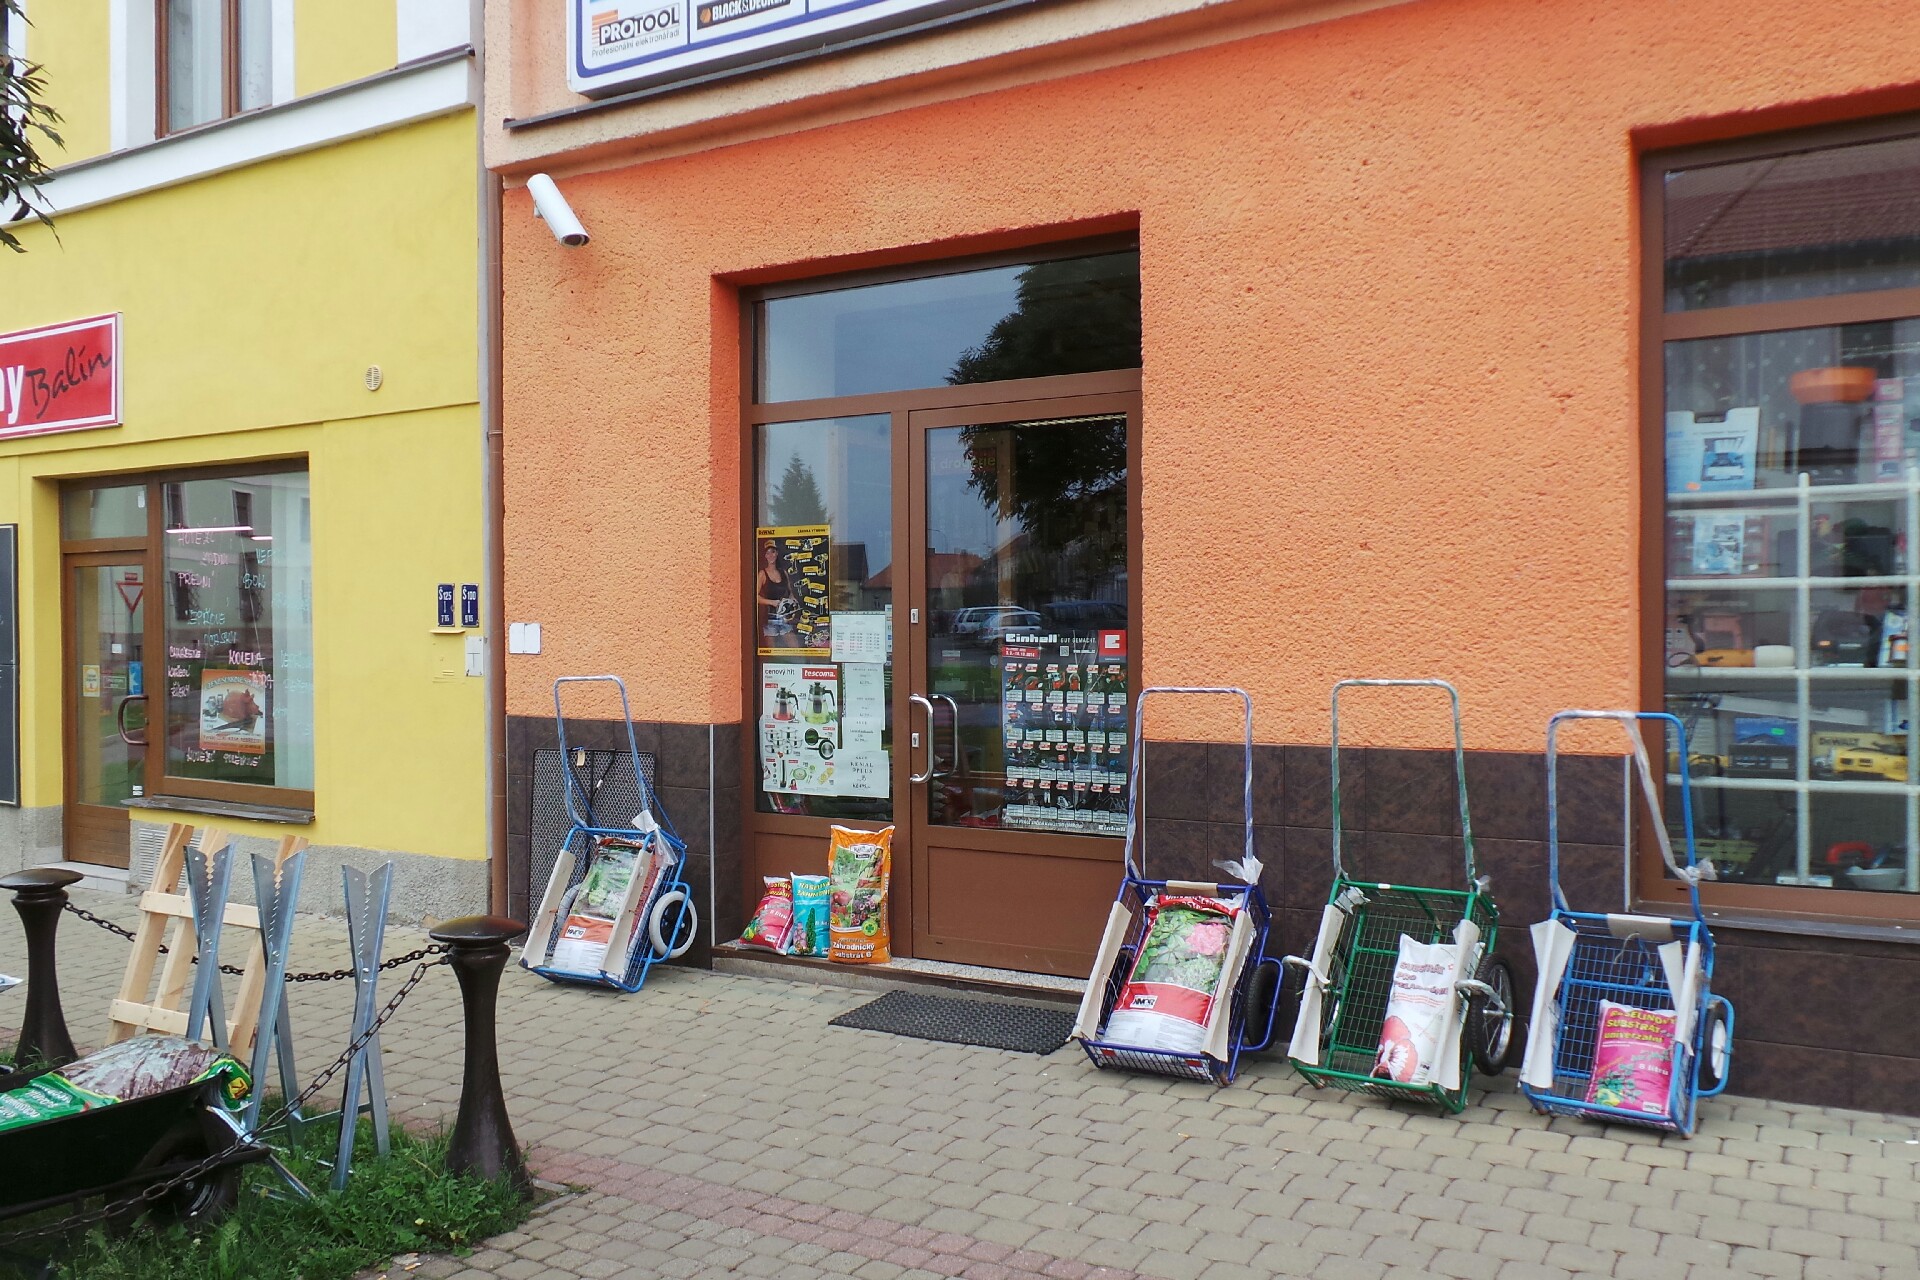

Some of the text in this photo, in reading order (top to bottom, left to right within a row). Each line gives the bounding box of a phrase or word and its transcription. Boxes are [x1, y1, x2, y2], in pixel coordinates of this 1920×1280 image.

[600, 7, 680, 44] PROTOOL
[25, 345, 112, 419] Balín
[1005, 633, 1058, 643] Einhell
[833, 941, 875, 951] Zahradnický
